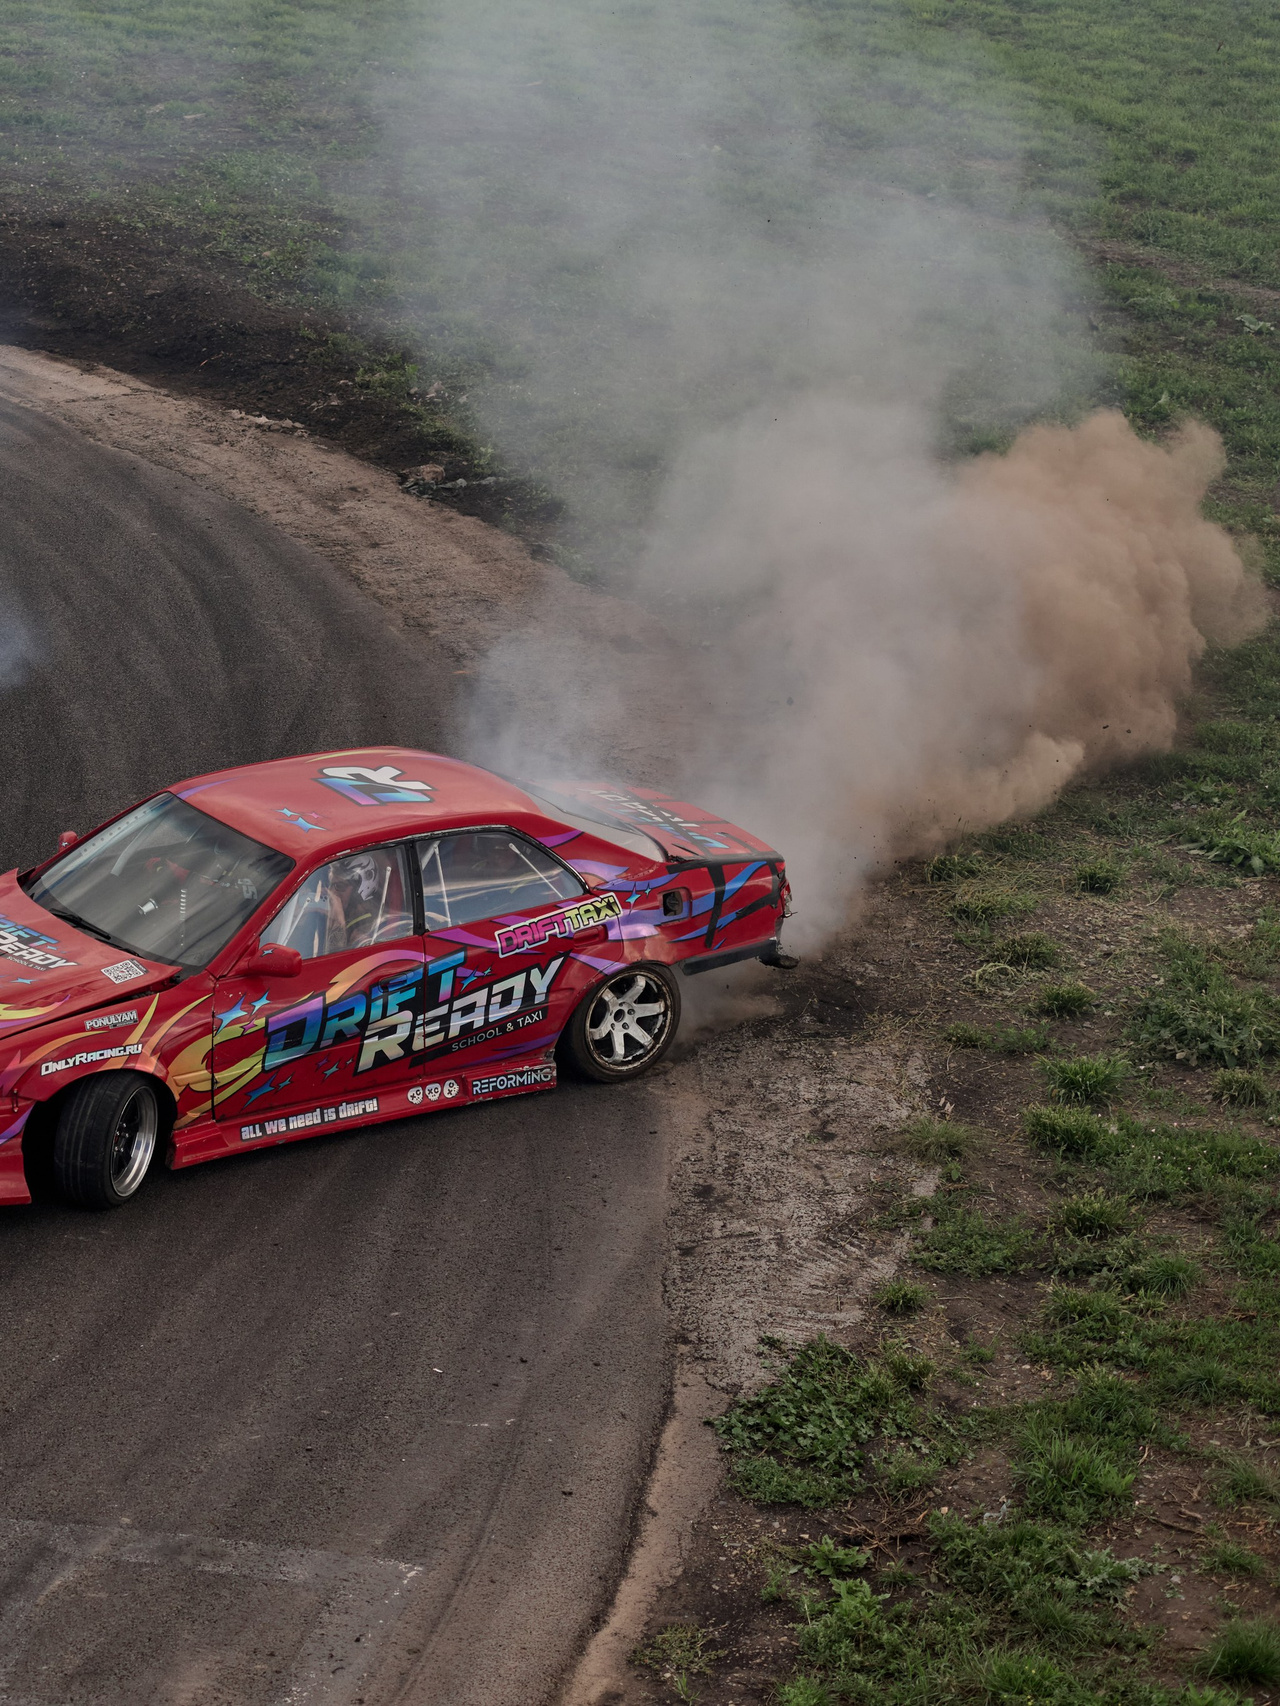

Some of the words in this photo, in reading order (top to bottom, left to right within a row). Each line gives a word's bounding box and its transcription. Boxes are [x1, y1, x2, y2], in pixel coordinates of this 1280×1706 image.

[86, 1010, 137, 1030] PONULYAM
[357, 957, 565, 1073] READY
[452, 1027, 502, 1052] SCHOOL
[506, 1022, 514, 1032] &
[517, 1011, 543, 1028] TAXI
[324, 1107, 337, 1122] is
